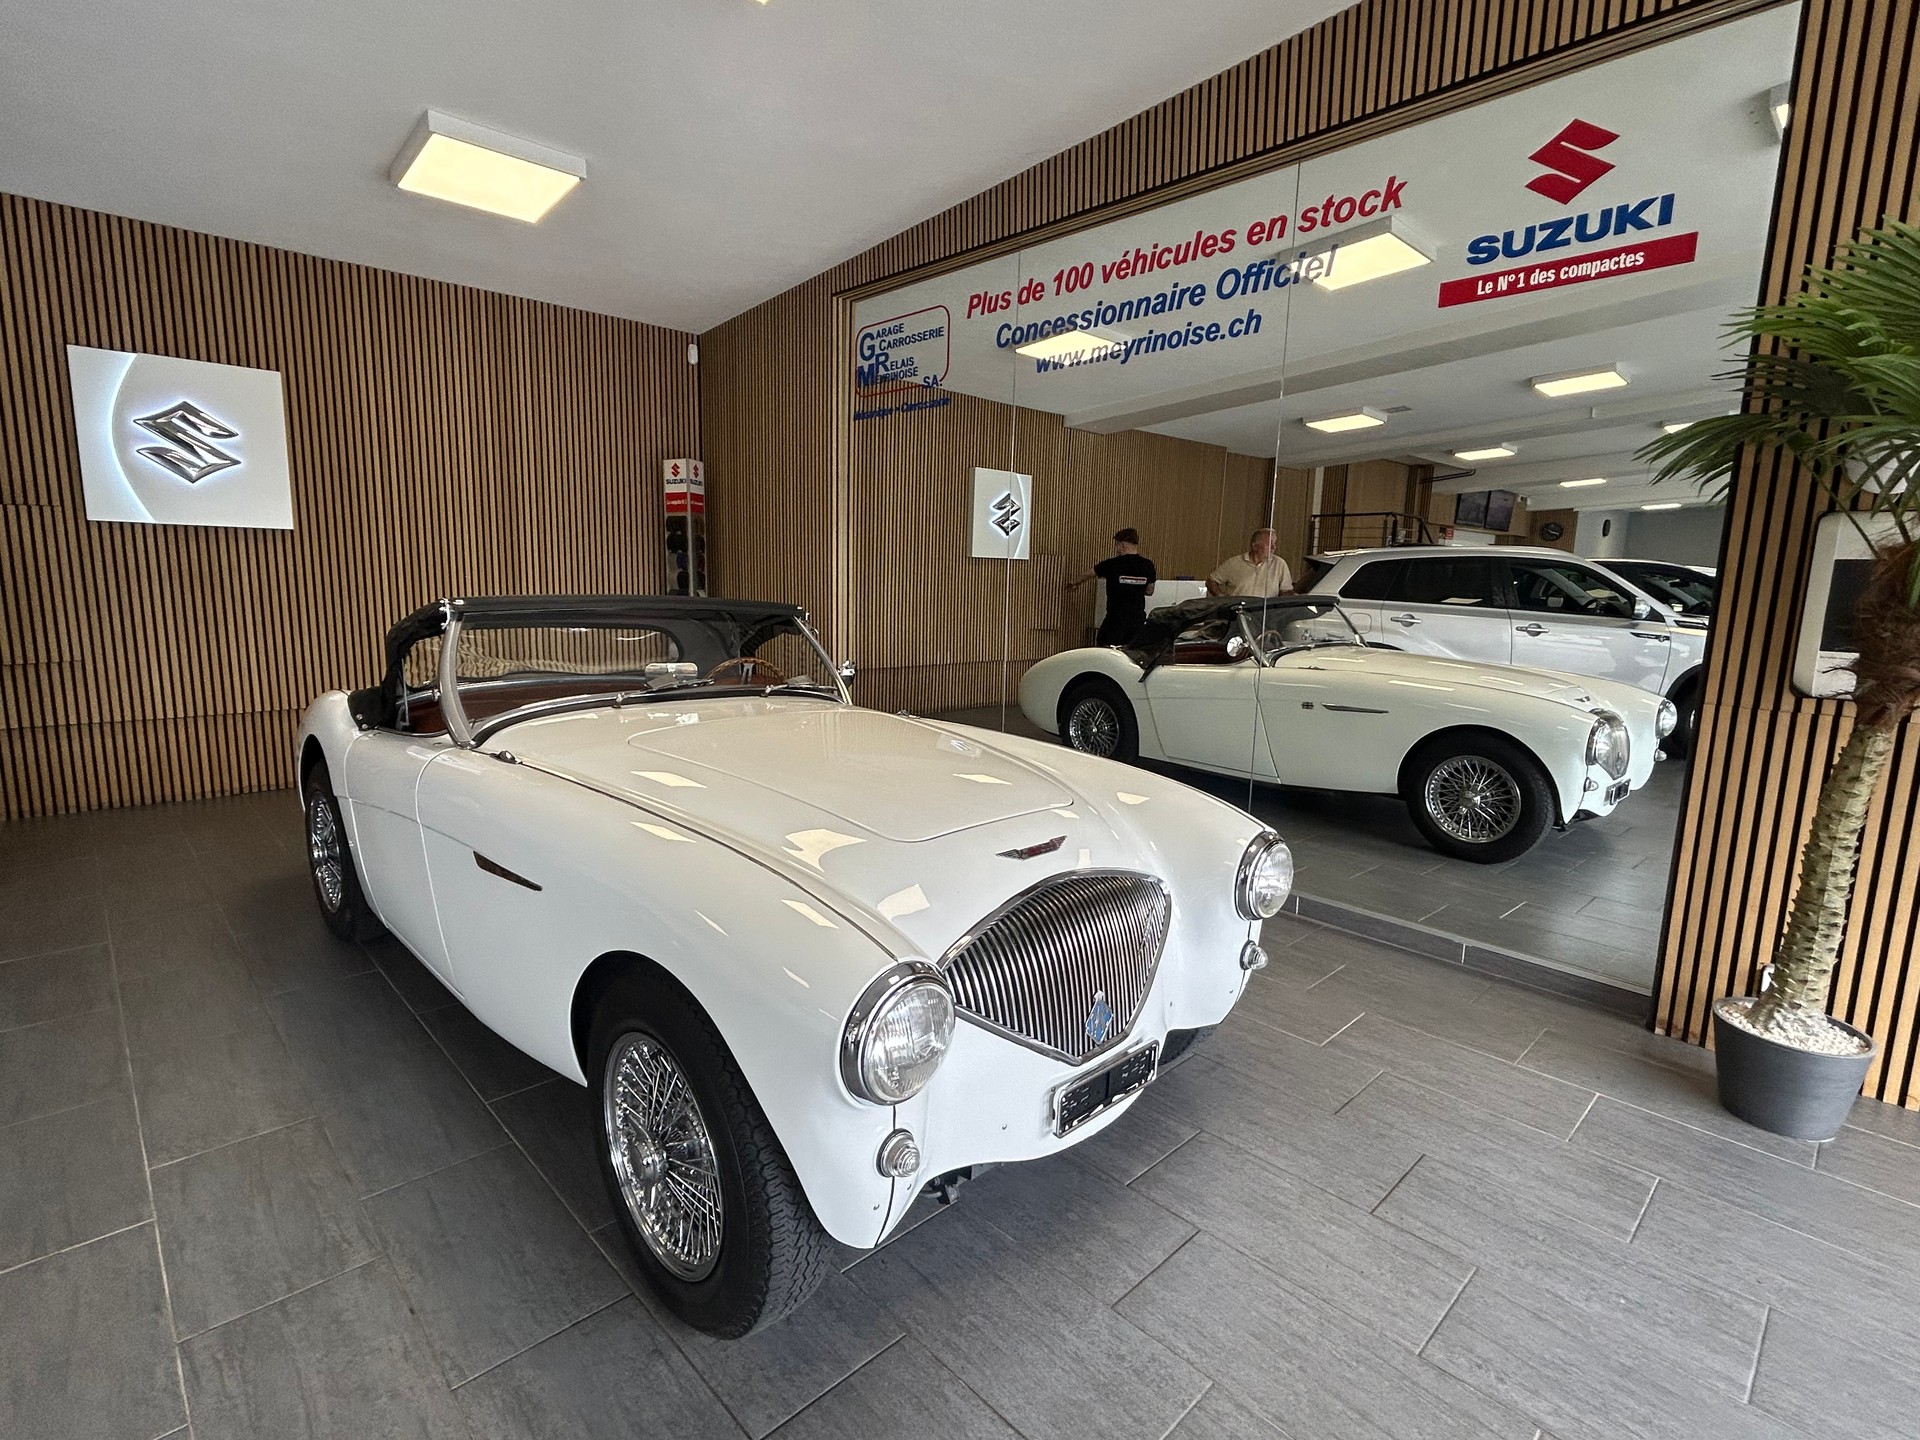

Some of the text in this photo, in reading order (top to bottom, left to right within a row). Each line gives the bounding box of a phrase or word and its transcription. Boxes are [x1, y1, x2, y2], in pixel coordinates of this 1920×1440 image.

[966, 175, 1408, 319] Plus de 100 véhicules en stock
[1466, 193, 1675, 266] SUZUKI
[996, 244, 1339, 349] Concessionnaire Officiel
[1477, 280, 1493, 295] Le
[1530, 269, 1556, 286] des
[1560, 251, 1645, 280] compactes
[859, 323, 905, 361] GARAGE
[875, 352, 915, 374] RELAIS
[878, 326, 945, 352] CARROSSERIE
[1036, 308, 1263, 374] www.meyrinoise.ch
